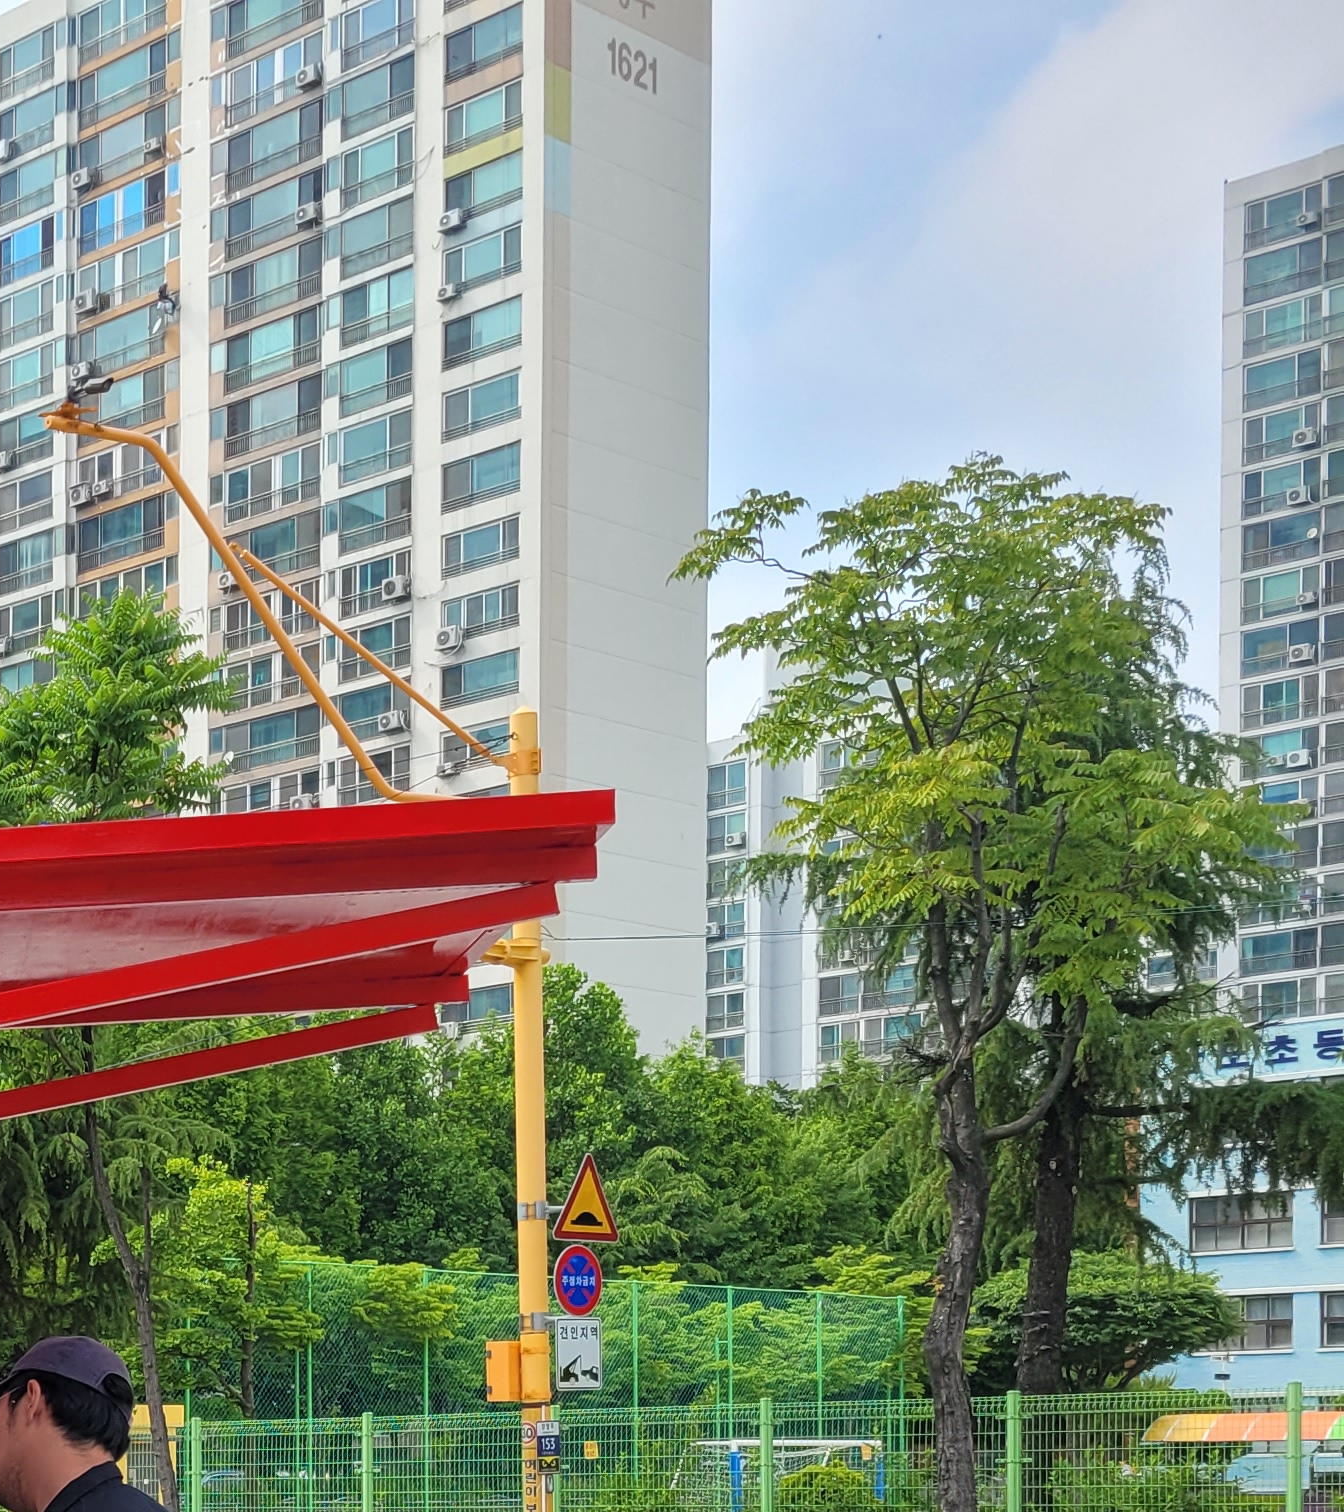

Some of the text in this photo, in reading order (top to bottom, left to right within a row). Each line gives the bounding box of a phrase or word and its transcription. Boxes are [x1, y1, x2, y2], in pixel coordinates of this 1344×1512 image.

[607, 38, 657, 95] 1621
[562, 1275, 596, 1287] 주정차금지
[559, 1325, 598, 1340] 견인지역
[541, 1437, 555, 1450] 153
[524, 1460, 536, 1497] 어린이
